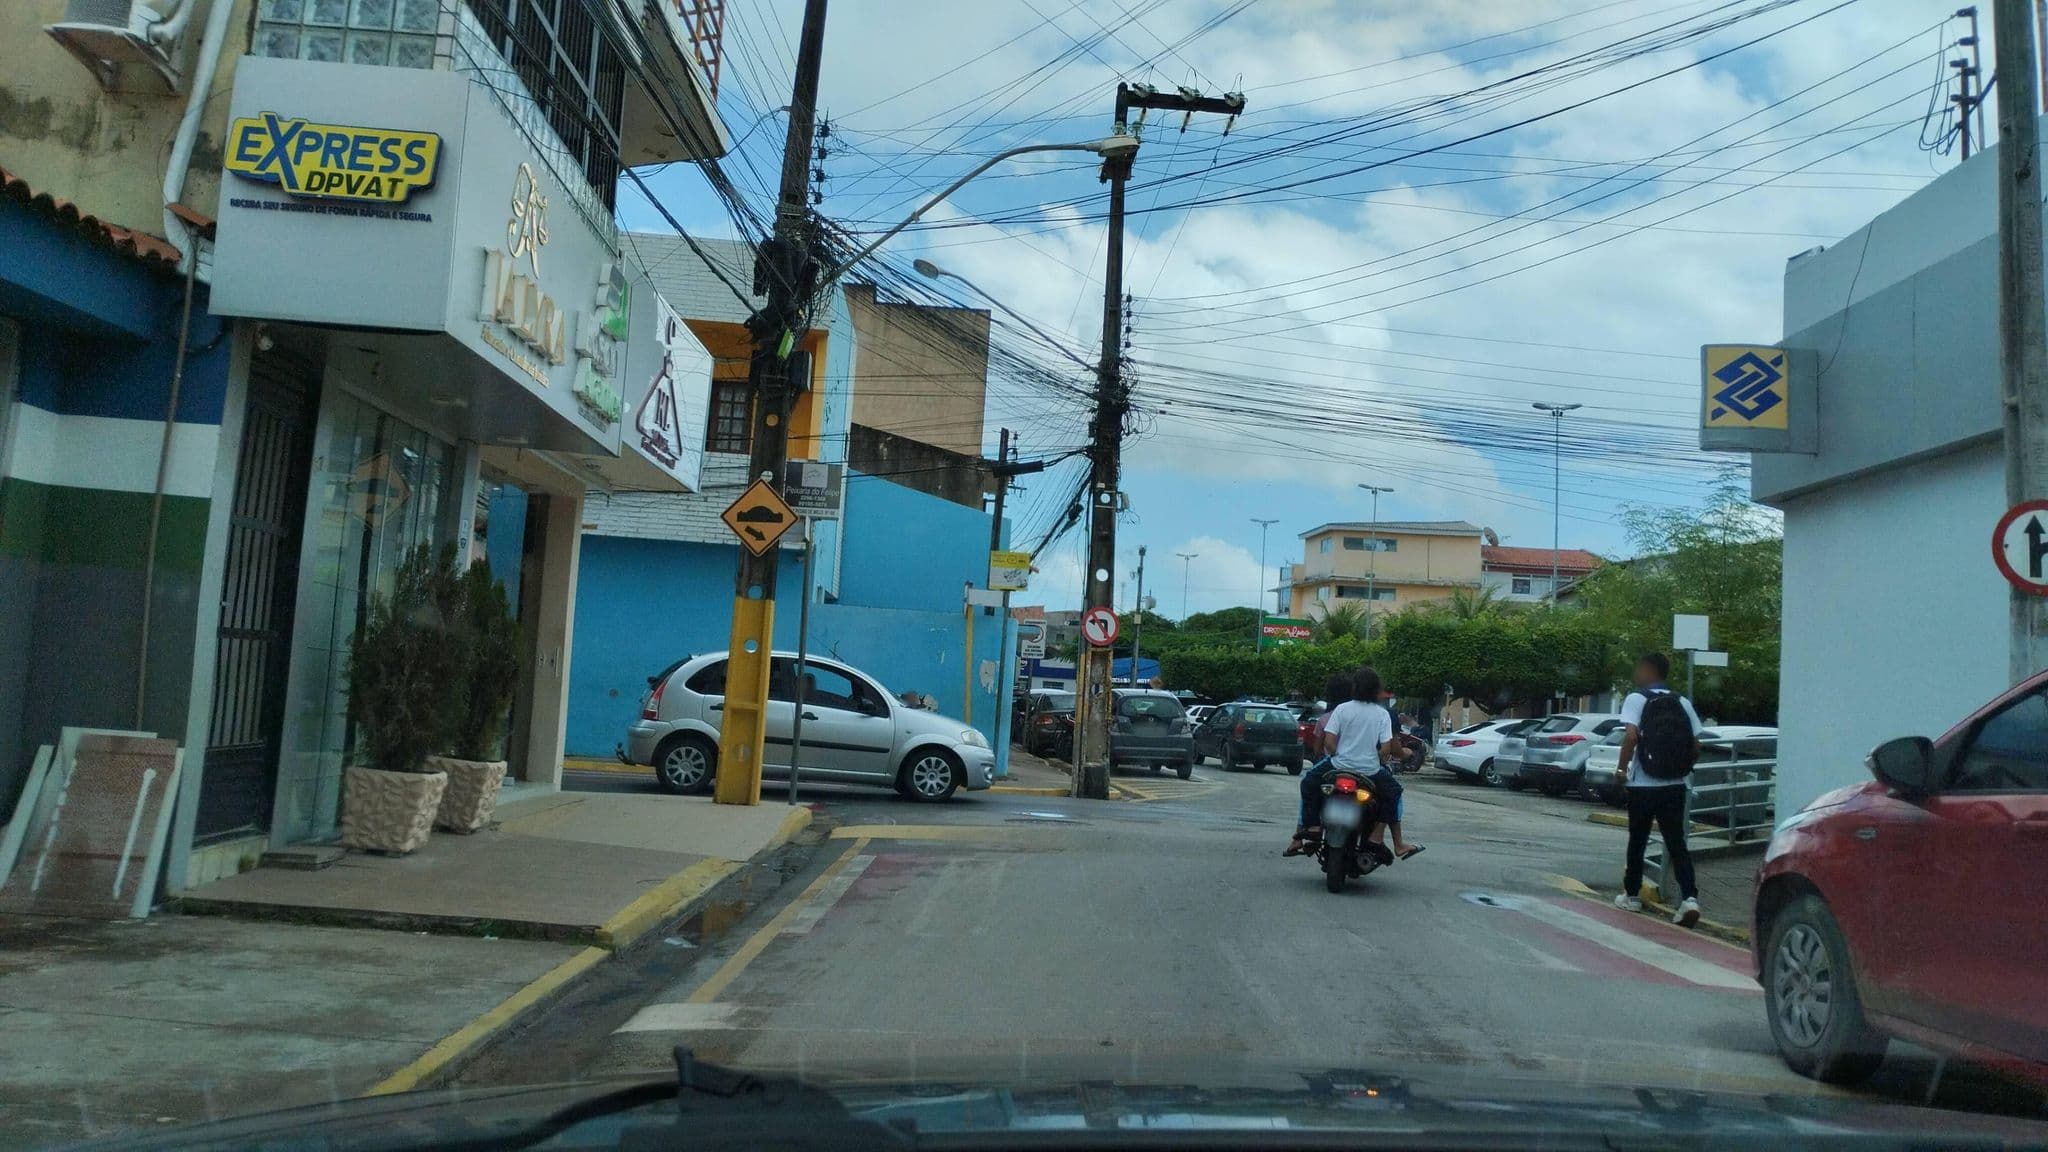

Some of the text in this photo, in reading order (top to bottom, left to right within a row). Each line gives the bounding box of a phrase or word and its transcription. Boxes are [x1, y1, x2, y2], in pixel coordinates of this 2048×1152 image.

[235, 114, 427, 190] EXPRESS
[304, 170, 404, 198] DPVAT
[399, 210, 432, 223] SEGURA
